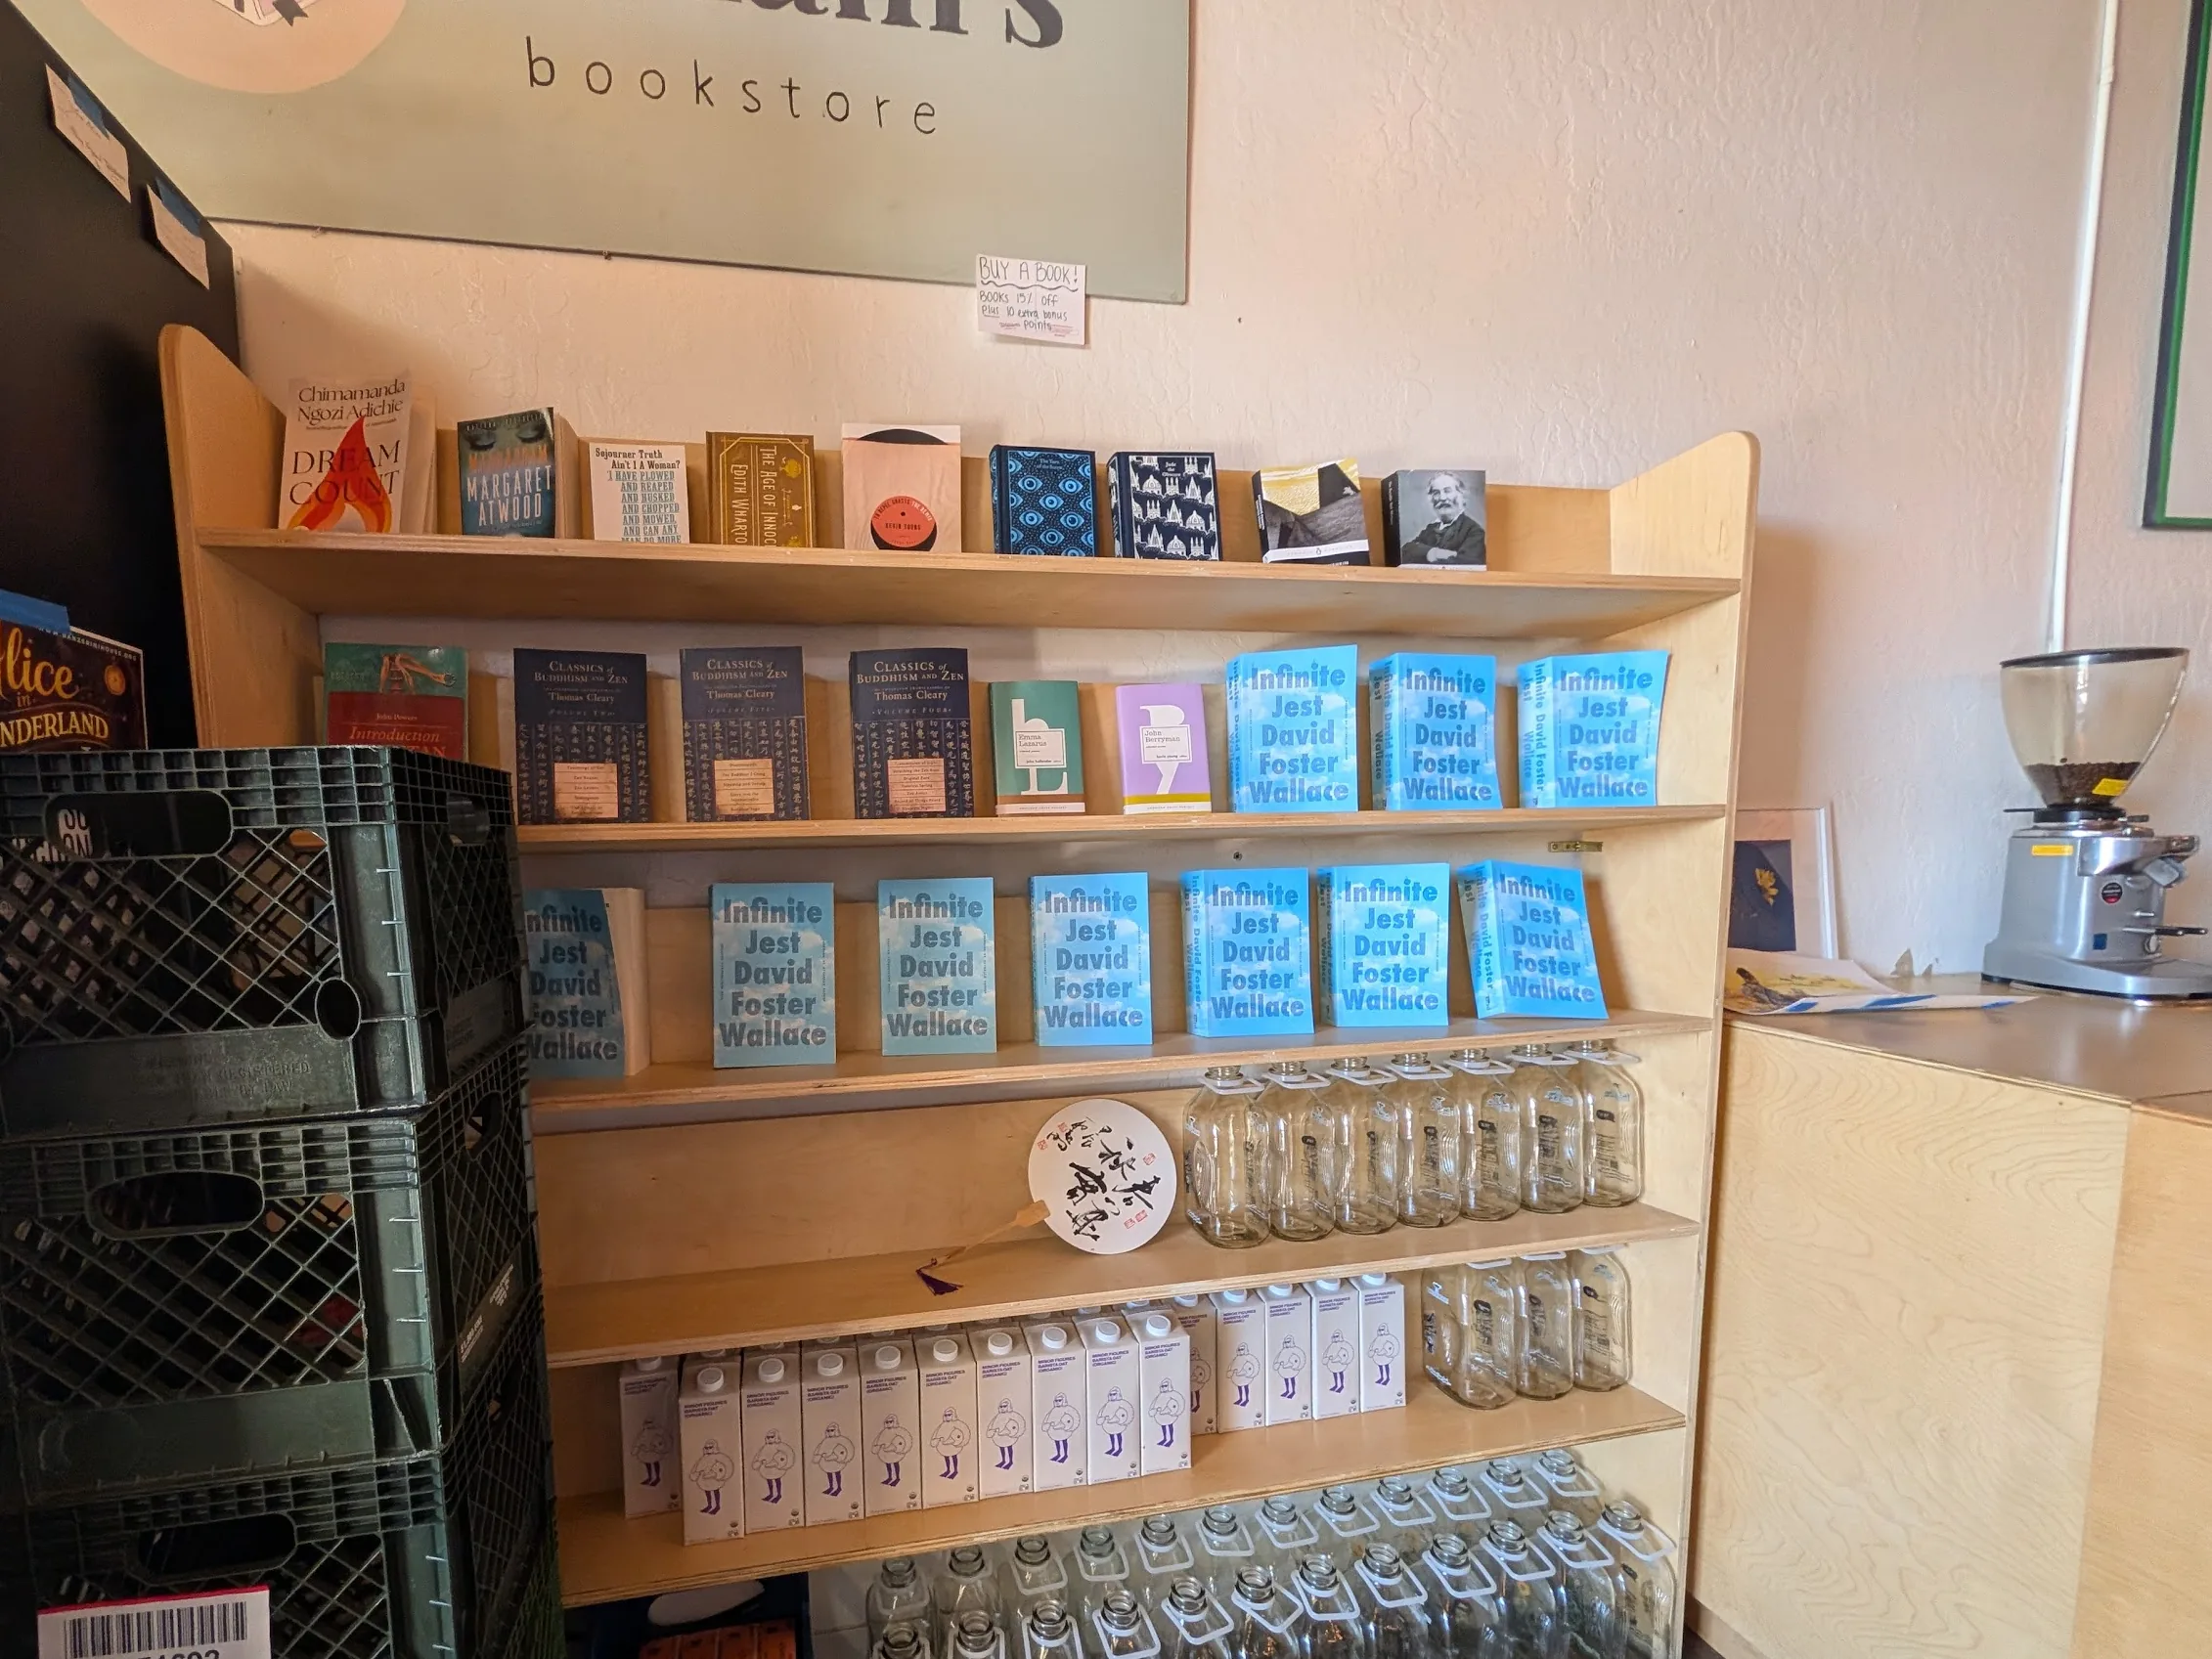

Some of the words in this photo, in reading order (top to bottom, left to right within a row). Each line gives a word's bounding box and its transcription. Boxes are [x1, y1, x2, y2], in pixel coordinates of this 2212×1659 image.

[526, 35, 937, 135] bookstore
[979, 256, 1009, 281] BUY
[1019, 261, 1030, 281] A
[1035, 261, 1079, 285] BOOK!
[1016, 292, 1033, 305] 15%
[1006, 306, 1015, 318] 10
[1017, 309, 1040, 320] extra
[1042, 309, 1068, 322] bonus
[298, 378, 406, 403] Chimamanda
[297, 405, 344, 426] Ngozi
[346, 398, 404, 419] Adichie
[292, 439, 401, 475] DREAM
[595, 447, 636, 460] Sojourner
[638, 449, 662, 459] Truth
[611, 459, 631, 470] Ain't
[640, 460, 645, 470] A
[646, 459, 681, 470] Woman?
[760, 445, 777, 466] THE
[289, 470, 399, 506] COUNT
[466, 464, 552, 502] MARGARET
[615, 471, 638, 481] HAVE
[640, 470, 675, 481] PLOWED
[620, 482, 639, 492] AND
[641, 481, 674, 492] REAPED
[730, 463, 749, 495] EDITH
[760, 470, 776, 491] AGE
[478, 493, 542, 527] ATWOOD
[621, 493, 639, 502] AND
[641, 493, 675, 502] HUSKED
[622, 503, 640, 514] AND
[641, 502, 680, 513] CHOPPED
[763, 494, 775, 507] OF
[623, 514, 641, 525] AND
[623, 526, 641, 536] AND
[642, 525, 659, 536] CAN
[662, 524, 678, 535] ANY
[760, 512, 778, 547] INNOC
[0, 627, 80, 700] lice
[549, 660, 604, 674] CLASSICS
[692, 671, 747, 681] BUDDHISM
[767, 669, 788, 679] ZEN
[706, 659, 764, 671] CLASSICS
[874, 661, 935, 673] CLASSICS
[1251, 662, 1346, 690] Infinite
[534, 672, 588, 682] BUDDHISM
[607, 674, 629, 684] ZEN
[857, 673, 918, 684] BUDDHISM
[941, 670, 964, 681] ZEN
[1406, 667, 1486, 694] Infinite
[1534, 663, 1547, 709] Infinite
[1560, 666, 1654, 692] Infinite
[16, 691, 32, 709] in
[548, 691, 584, 702] Thomas
[586, 692, 615, 704] Cleary
[706, 690, 742, 700] Thomas
[745, 688, 775, 700] Cleary
[874, 691, 912, 701] Thomas
[915, 690, 948, 702] Cleary
[1271, 695, 1324, 719] Jest
[1424, 696, 1468, 720] Jest
[1578, 695, 1628, 719] Jest
[349, 725, 440, 743] Introduction
[1261, 719, 1335, 747] David
[1415, 722, 1477, 748] David
[1535, 714, 1547, 752] David
[1570, 720, 1638, 745] David
[1260, 752, 1339, 775] Foster
[1412, 750, 1481, 775] Foster
[1536, 753, 1547, 792] Foster
[1567, 750, 1640, 772] Foster
[1249, 777, 1349, 804] Wallace
[1402, 777, 1492, 802] Wallace
[1558, 773, 1648, 799] Wallace
[1043, 887, 1138, 914] Infinite
[1212, 882, 1300, 907] Infinite
[1345, 878, 1438, 903] Infinite
[1498, 873, 1576, 903] Infinite
[723, 895, 823, 925] Infinite
[888, 892, 984, 920] Infinite
[1364, 907, 1416, 930] Jest
[1519, 900, 1562, 927] Jest
[1065, 918, 1118, 942] Jest
[1231, 911, 1280, 936] Jest
[745, 930, 801, 955] Jest
[909, 924, 963, 949] Jest
[1354, 932, 1426, 957] David
[1512, 925, 1575, 952] David
[1055, 944, 1128, 972] David
[1222, 938, 1290, 963] David
[1512, 949, 1581, 977] Foster
[733, 957, 813, 985] David
[900, 951, 974, 979] David
[1352, 961, 1430, 983] Foster
[1053, 976, 1133, 1000] Foster
[1220, 968, 1294, 991] Foster
[1504, 975, 1596, 1004] Wallace
[730, 991, 817, 1017] Foster
[897, 983, 978, 1008] Foster
[1210, 993, 1305, 1020] Wallace
[1341, 986, 1438, 1011] Wallace
[886, 1011, 989, 1037] Wallace
[1043, 1002, 1143, 1028] Wallace
[719, 1020, 826, 1048] Wallace
